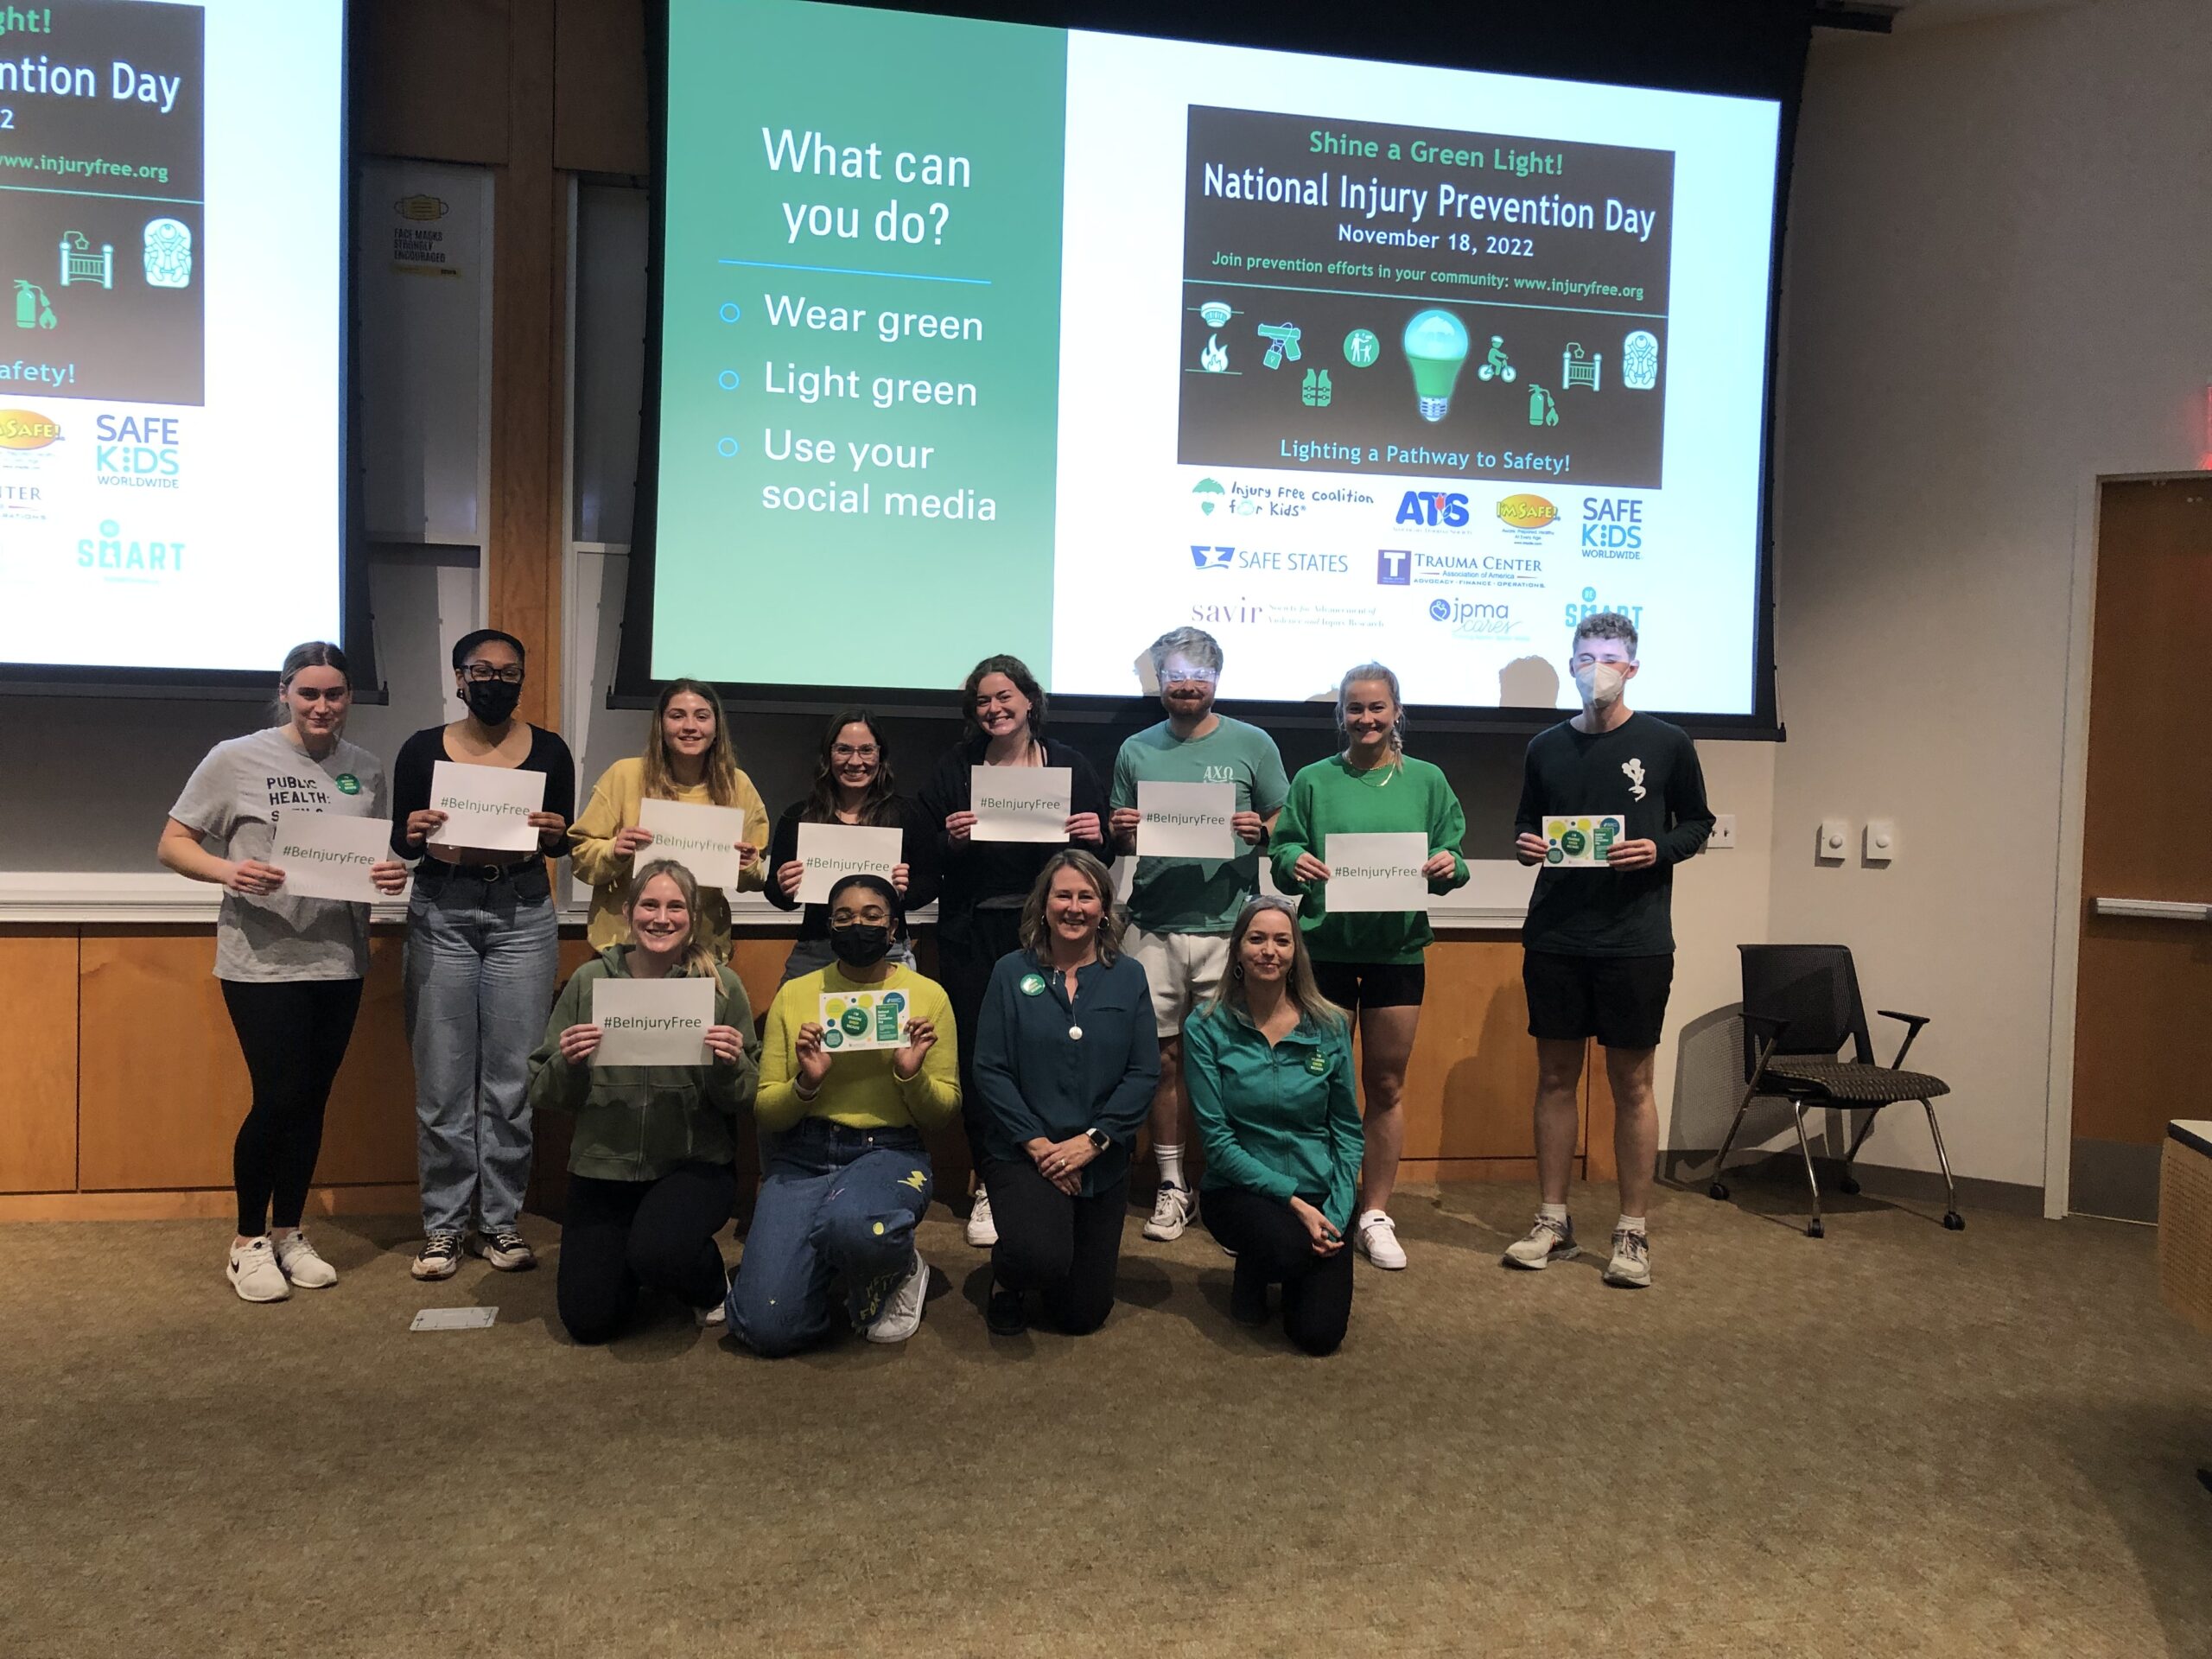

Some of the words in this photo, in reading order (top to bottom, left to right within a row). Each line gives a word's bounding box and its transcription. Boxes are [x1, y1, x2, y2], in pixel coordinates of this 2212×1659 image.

[112, 61, 181, 114] Day
[761, 127, 882, 180] What
[894, 151, 970, 188] can
[1310, 130, 1378, 160] Shine
[1387, 145, 1402, 161] a
[1410, 141, 1484, 168] Green
[1493, 149, 1563, 176] Light!
[1204, 163, 1328, 206] National
[1340, 175, 1427, 222] Injury
[1439, 184, 1594, 229] Prevention
[1605, 200, 1656, 242] Day
[781, 202, 859, 244] you
[874, 199, 950, 245] do?
[1338, 224, 1440, 249] November
[1447, 233, 1478, 256] 18,
[1486, 237, 1534, 257] 2022
[1212, 251, 1242, 267] Join
[1247, 256, 1323, 274] prevention
[1327, 260, 1374, 276] efforts
[1378, 264, 1391, 277] in
[1395, 268, 1426, 282] your
[1431, 269, 1510, 288] community:
[1514, 276, 1644, 301] www.injuryfree.org
[764, 294, 866, 333] Wear
[878, 310, 983, 343] green
[766, 360, 860, 404] Light
[872, 377, 977, 408] green
[97, 414, 179, 445] SAFE
[765, 429, 836, 464] Use
[848, 440, 934, 473] your
[1281, 439, 1361, 465] Lighting
[1368, 448, 1379, 462] a
[1387, 445, 1469, 471] Pathway
[1477, 450, 1497, 468] to
[1503, 451, 1570, 476] Safety!
[98, 475, 180, 489] WORLDWIDE
[1231, 481, 1271, 499] Injury
[761, 480, 869, 514] social
[884, 488, 996, 521] media
[1395, 490, 1470, 528] ATS
[1582, 497, 1643, 524] SAFE
[1238, 550, 1281, 570] SAFE
[1287, 553, 1348, 572] STATES
[1414, 553, 1478, 569] TRAUMA
[1483, 556, 1542, 572] CENTER
[1581, 549, 1641, 561] WORLDWIDE
[1191, 596, 1263, 623] savir
[1452, 598, 1510, 623] jpma
[266, 776, 317, 790] PUBLIC
[269, 791, 331, 806] HEALTH:
[441, 796, 531, 817] #BeInjuryFree
[980, 797, 1061, 811] #BeInjuryFree
[1146, 812, 1225, 828] #BeInjuryFree
[283, 845, 376, 867] #BeInjuryFree
[805, 856, 891, 874] #BeInjuryFree
[1334, 864, 1418, 880] #BeInjuryFree
[603, 1015, 702, 1032] #BeInjuryFree
